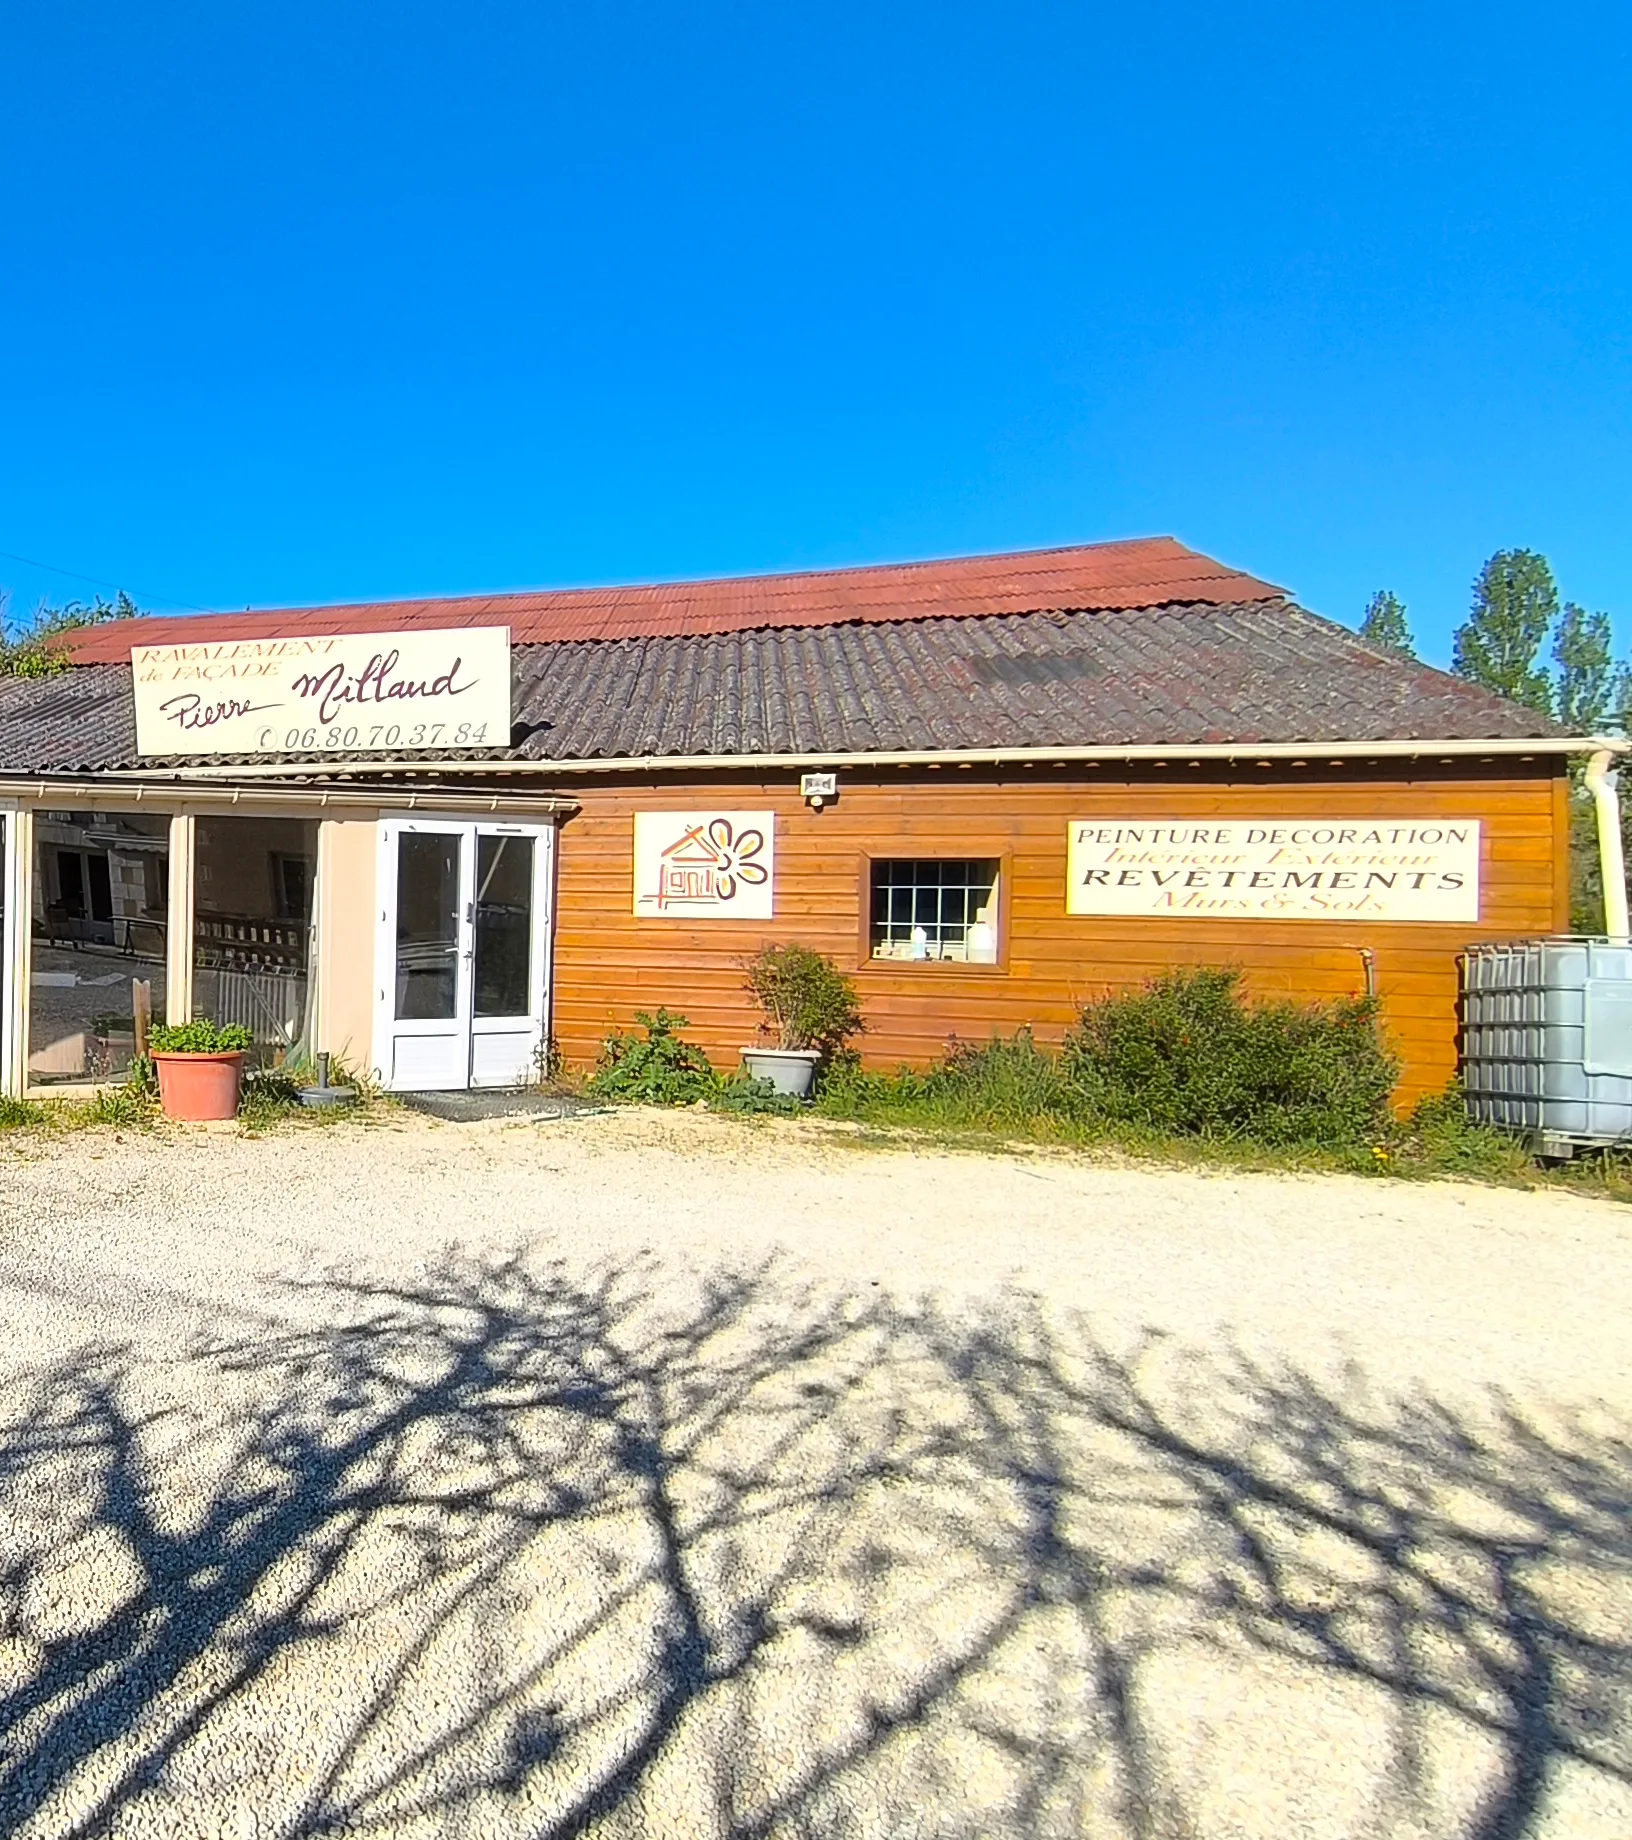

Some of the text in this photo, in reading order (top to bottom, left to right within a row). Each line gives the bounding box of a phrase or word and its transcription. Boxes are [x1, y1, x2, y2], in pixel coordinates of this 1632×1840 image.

[140, 638, 344, 664] RAVALEMENT
[139, 661, 283, 684] de FAÇADE
[159, 649, 481, 730] Pierre Millaud
[284, 722, 489, 750] 06.80.70.37.84
[1076, 828, 1470, 845] PEINTURE DECORATION
[1103, 847, 1440, 866] Intérieur Extérieur
[1081, 866, 1465, 890] REVÊTEMENTS
[1151, 891, 1388, 911] Murs & Sols
